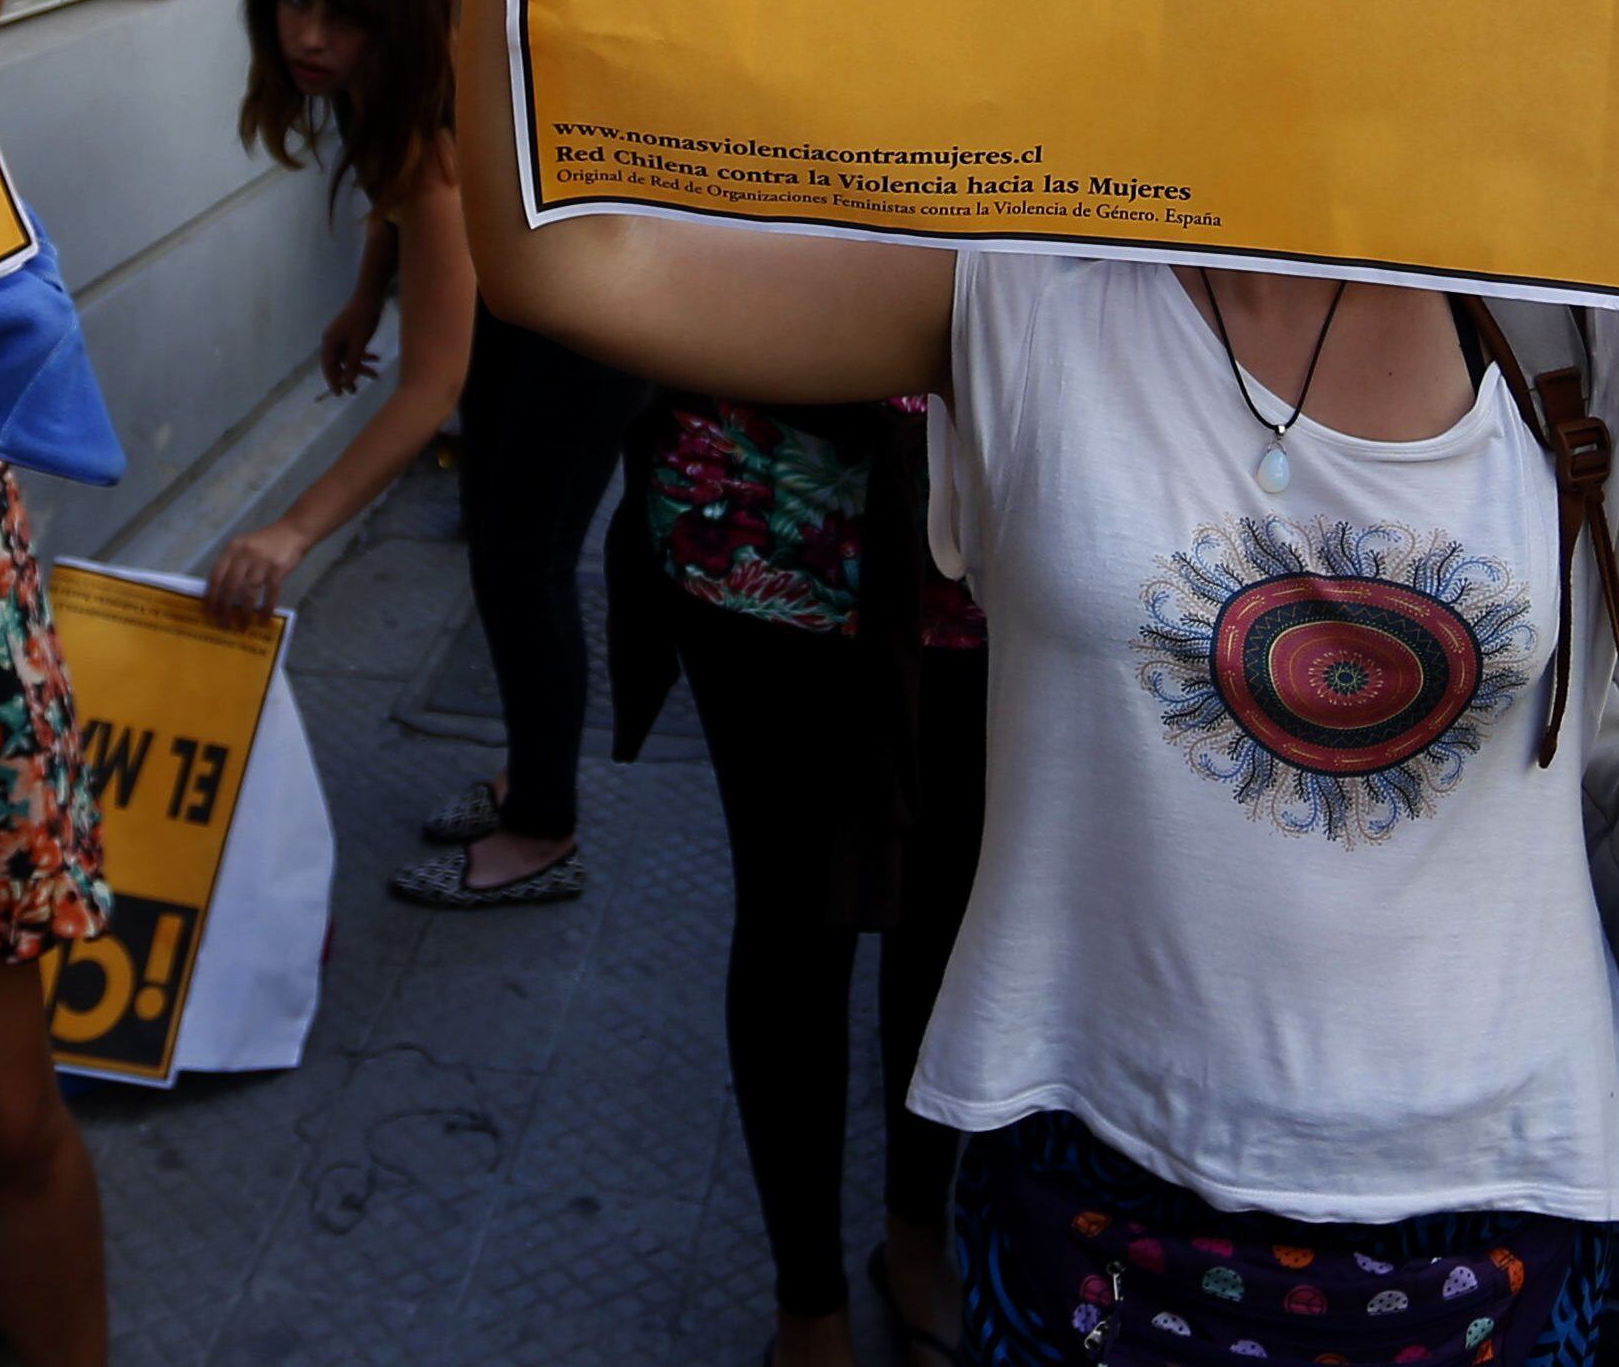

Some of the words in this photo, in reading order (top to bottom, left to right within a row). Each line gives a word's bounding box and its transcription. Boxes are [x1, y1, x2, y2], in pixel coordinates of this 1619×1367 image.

[552, 122, 1043, 170] www.nomasviolenciacontramujeres.cl
[555, 145, 605, 164] Red
[613, 149, 709, 178] Chilena
[716, 167, 800, 186] contra
[808, 169, 830, 187] la
[837, 173, 958, 195] Violencia
[965, 174, 1034, 195] hacia
[1042, 174, 1080, 194] las
[1087, 176, 1192, 203] Mujeres
[556, 168, 623, 185] Original
[627, 170, 646, 186] de
[650, 175, 680, 191] Red
[684, 180, 703, 195] de
[706, 184, 828, 206] Organizaciones
[831, 193, 916, 214] Feministas
[920, 203, 971, 217] contra
[975, 201, 990, 216] la
[994, 200, 1068, 217] Violencia
[1072, 202, 1092, 218] de
[1095, 203, 1160, 223] Género.
[1164, 207, 1223, 229] España
[167, 736, 230, 826] EL
